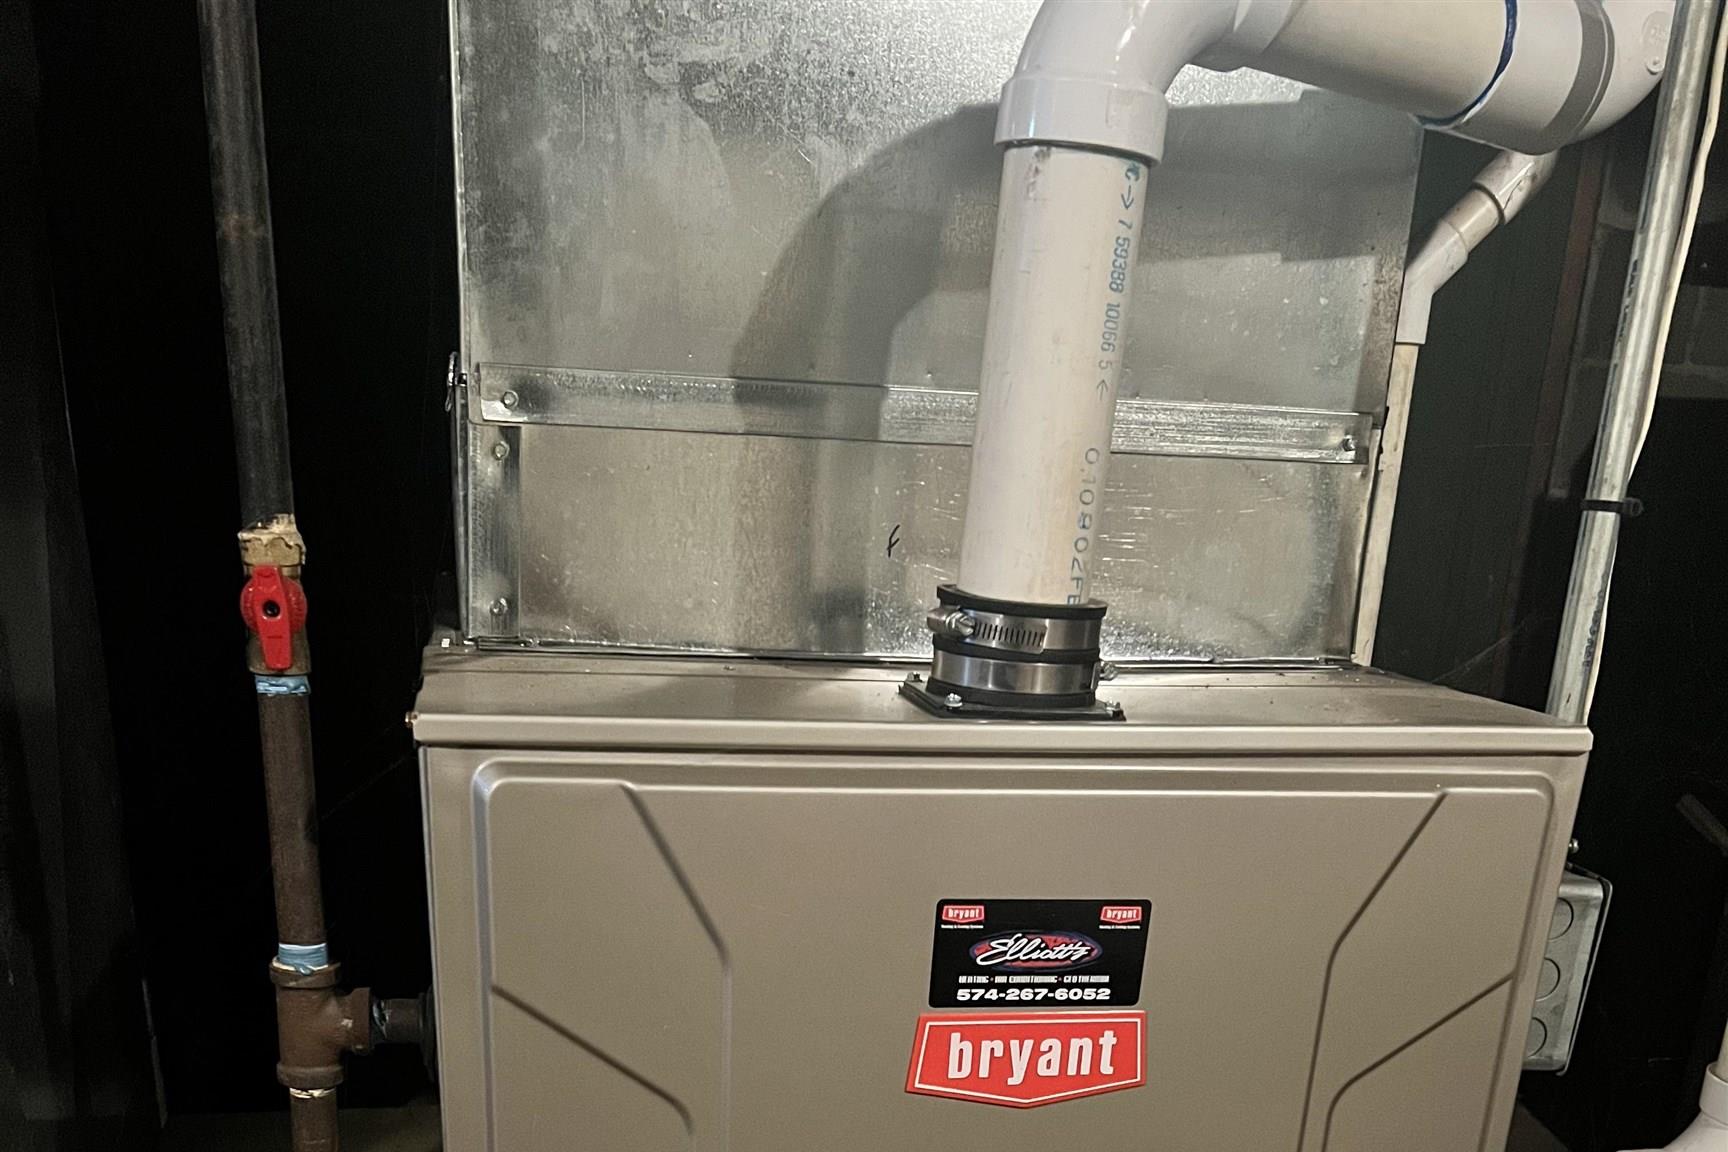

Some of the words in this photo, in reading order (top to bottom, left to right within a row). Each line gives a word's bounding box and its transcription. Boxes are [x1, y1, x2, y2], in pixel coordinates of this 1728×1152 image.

[1109, 235, 1131, 293] 59388
[1101, 302, 1121, 352] 10066
[1098, 359, 1113, 370] 5
[948, 908, 980, 920] bryant
[1106, 909, 1137, 920] bryant
[956, 988, 1111, 1001] 574-267-6052
[947, 1030, 1117, 1086] bryant
